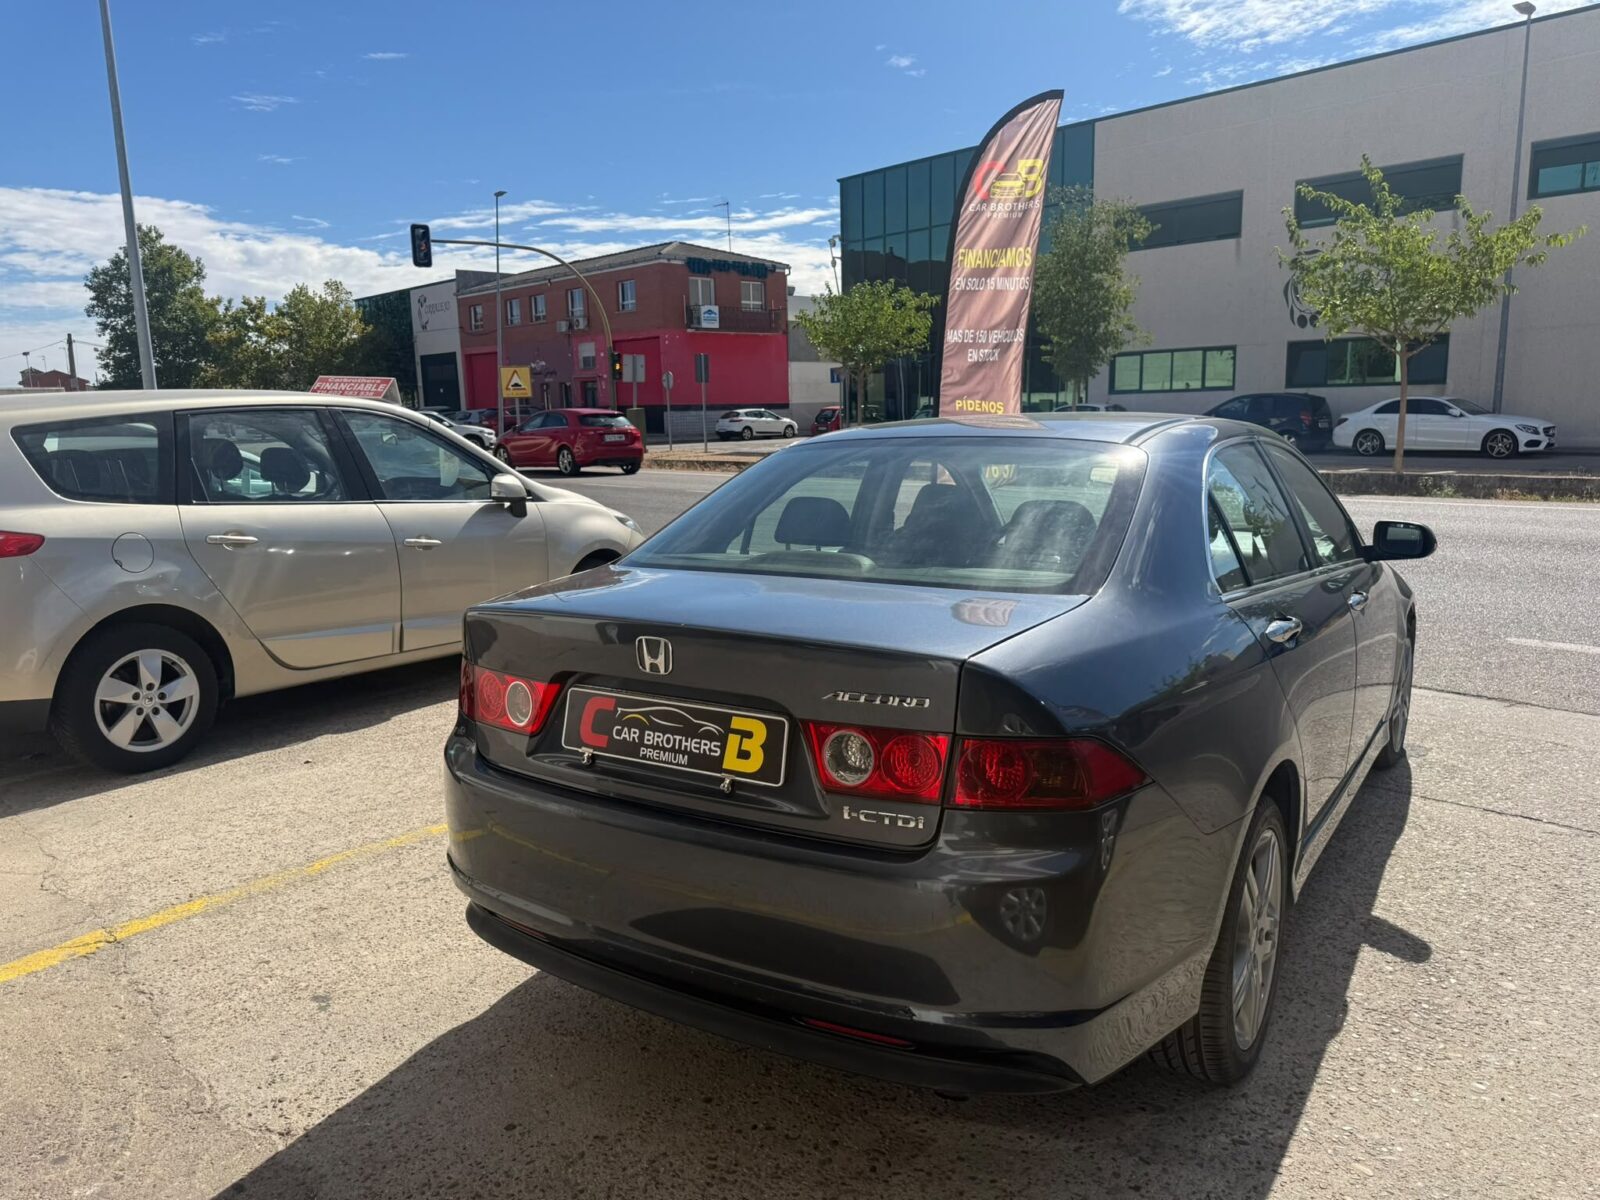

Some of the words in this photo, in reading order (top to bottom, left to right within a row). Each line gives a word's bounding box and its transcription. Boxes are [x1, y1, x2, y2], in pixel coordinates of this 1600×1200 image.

[1017, 158, 1043, 198] B
[969, 203, 987, 212] CAR
[958, 247, 1032, 268] FINANCIAMOS
[955, 277, 966, 291] EN
[966, 277, 985, 291] SOLO
[987, 277, 995, 290] 15
[996, 276, 1030, 291] MINUTOS
[946, 329, 963, 343] MAS
[964, 329, 974, 343] DE
[967, 349, 978, 362] EN
[979, 348, 1000, 362] STOCK
[314, 382, 387, 391] FINANCIABLE
[955, 395, 1004, 414] PÍDENOS
[822, 691, 930, 708] ACCORD
[579, 696, 617, 748] C
[612, 726, 639, 743] CAR
[644, 731, 721, 756] BROTHERS
[722, 716, 767, 773] B
[639, 747, 688, 765] PREMIUM
